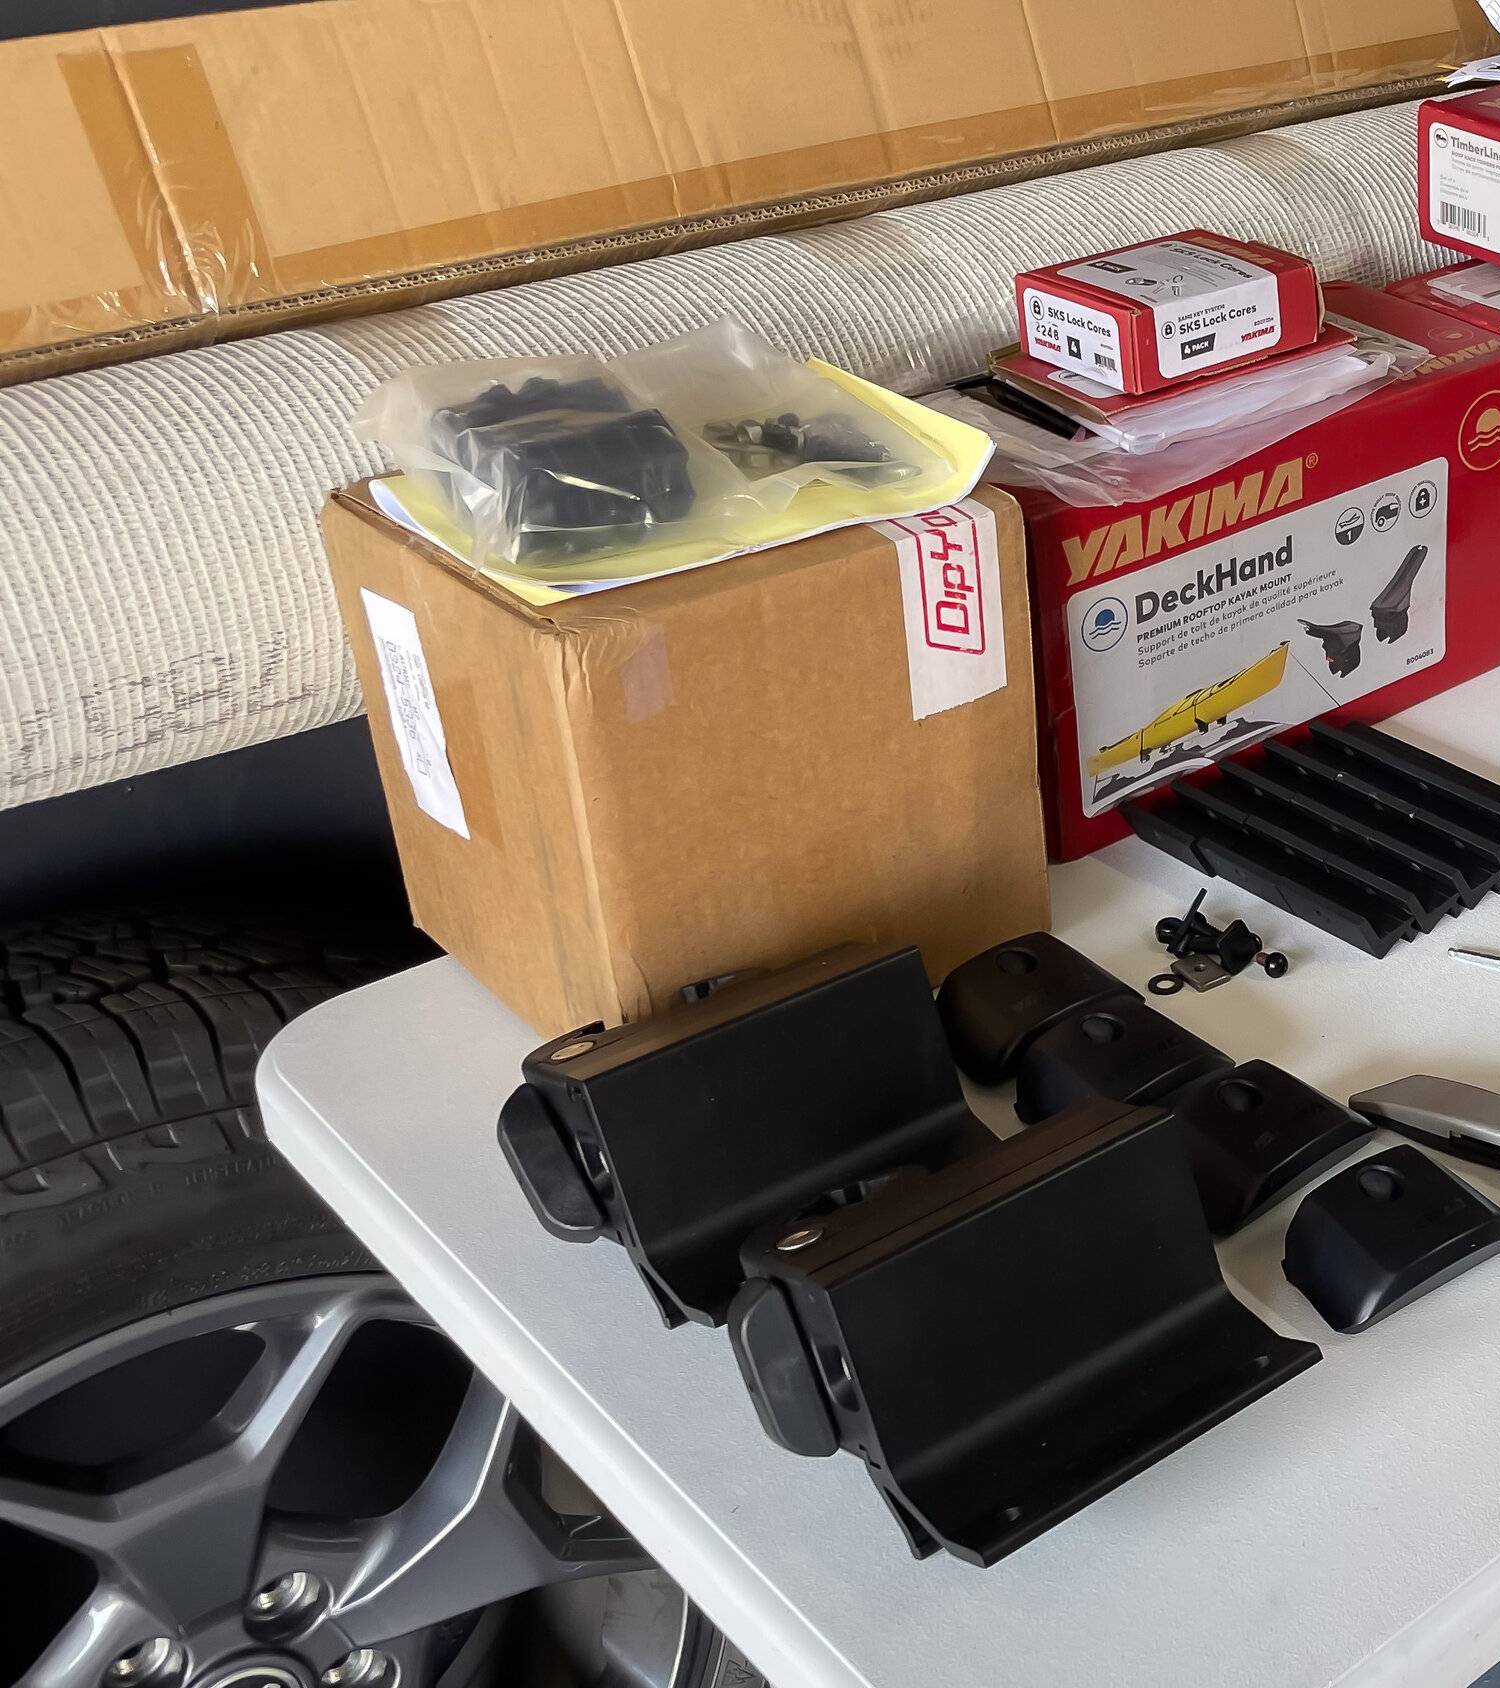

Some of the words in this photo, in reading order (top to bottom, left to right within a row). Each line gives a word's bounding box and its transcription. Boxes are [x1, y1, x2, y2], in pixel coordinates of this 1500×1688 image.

[1048, 307, 1066, 322] SKS
[1066, 312, 1086, 329] Lock
[1087, 320, 1111, 338] Cores
[1179, 319, 1201, 335] SKS
[1202, 312, 1227, 328] Lock
[1228, 304, 1257, 320] Cores
[1193, 310, 1204, 318] KEY
[1034, 337, 1061, 353] YAKIMA
[1070, 340, 1078, 354] 4
[1184, 344, 1191, 355] 4
[1191, 340, 1210, 352] PACK
[1240, 325, 1276, 343] YAKIMA
[1061, 457, 1304, 586] YAKIMA
[1135, 535, 1293, 625] DeckHand
[1136, 619, 1182, 643] PREMIUM
[1182, 600, 1227, 626] ROOFTOP
[1228, 586, 1259, 607] KAYAK
[1259, 573, 1293, 594] MOUNT
[1138, 634, 1176, 655] Support
[1177, 628, 1188, 640] de
[1209, 615, 1221, 626] de
[1222, 605, 1247, 623] kayak
[1249, 599, 1260, 610] de
[1261, 586, 1292, 607] qualité
[1292, 569, 1338, 592] supérieure
[1138, 648, 1176, 669] Soporte
[1177, 641, 1189, 652] de
[1190, 629, 1216, 648] techo
[1217, 625, 1229, 636] de
[1230, 610, 1264, 632] primera
[1265, 596, 1297, 615] calidad
[1298, 588, 1318, 605] para
[1319, 576, 1345, 596] kayak
